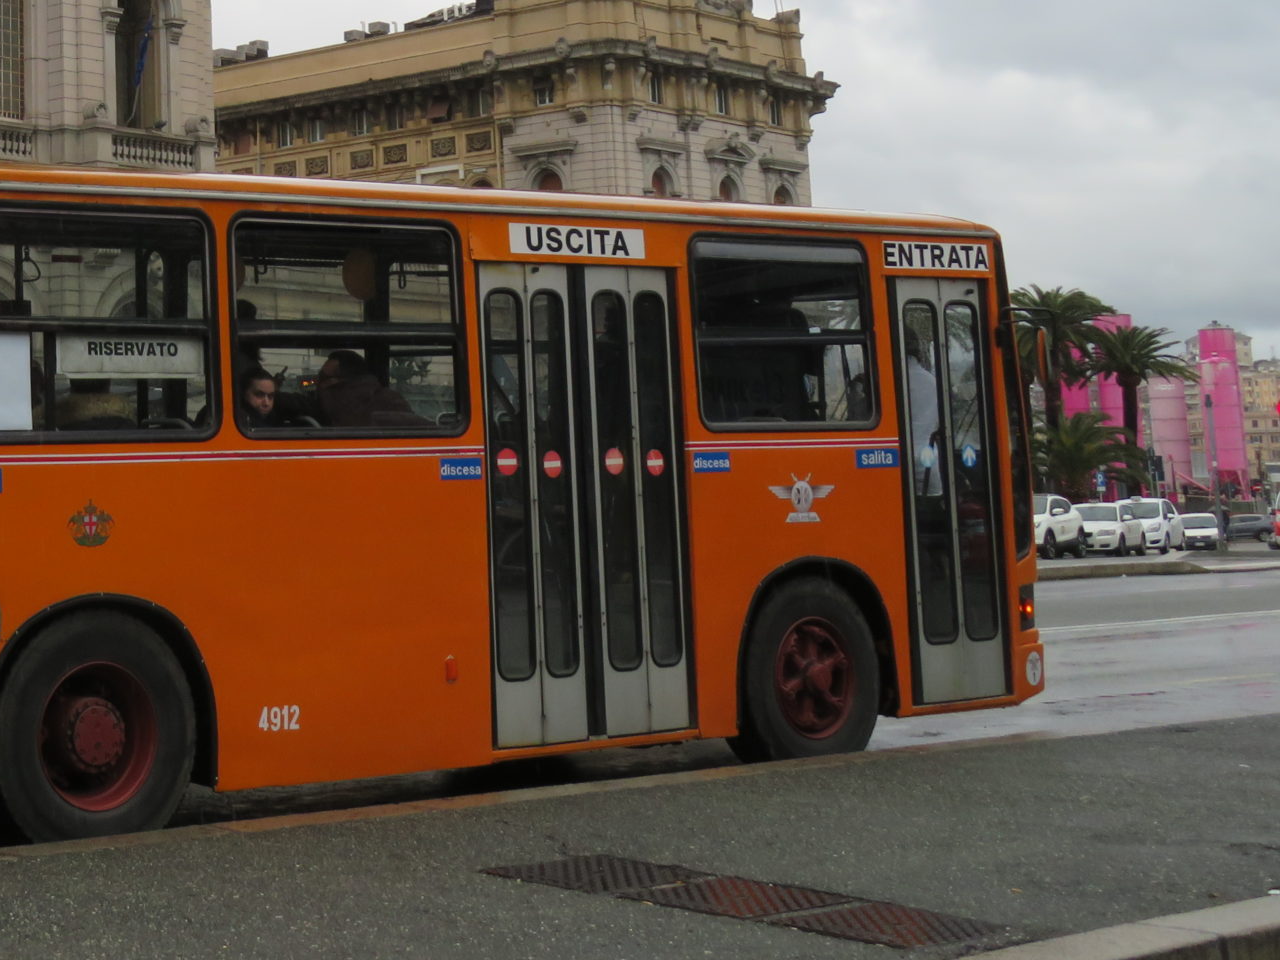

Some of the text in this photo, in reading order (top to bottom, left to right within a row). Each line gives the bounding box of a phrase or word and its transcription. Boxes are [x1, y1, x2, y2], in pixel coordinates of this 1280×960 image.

[525, 226, 630, 256] USCITA
[883, 242, 989, 269] ENTRATA
[87, 341, 178, 357] RISERVATO
[693, 456, 730, 469] discesa
[861, 450, 893, 465] salita
[440, 464, 482, 476] discesa
[258, 704, 300, 732] 4912
